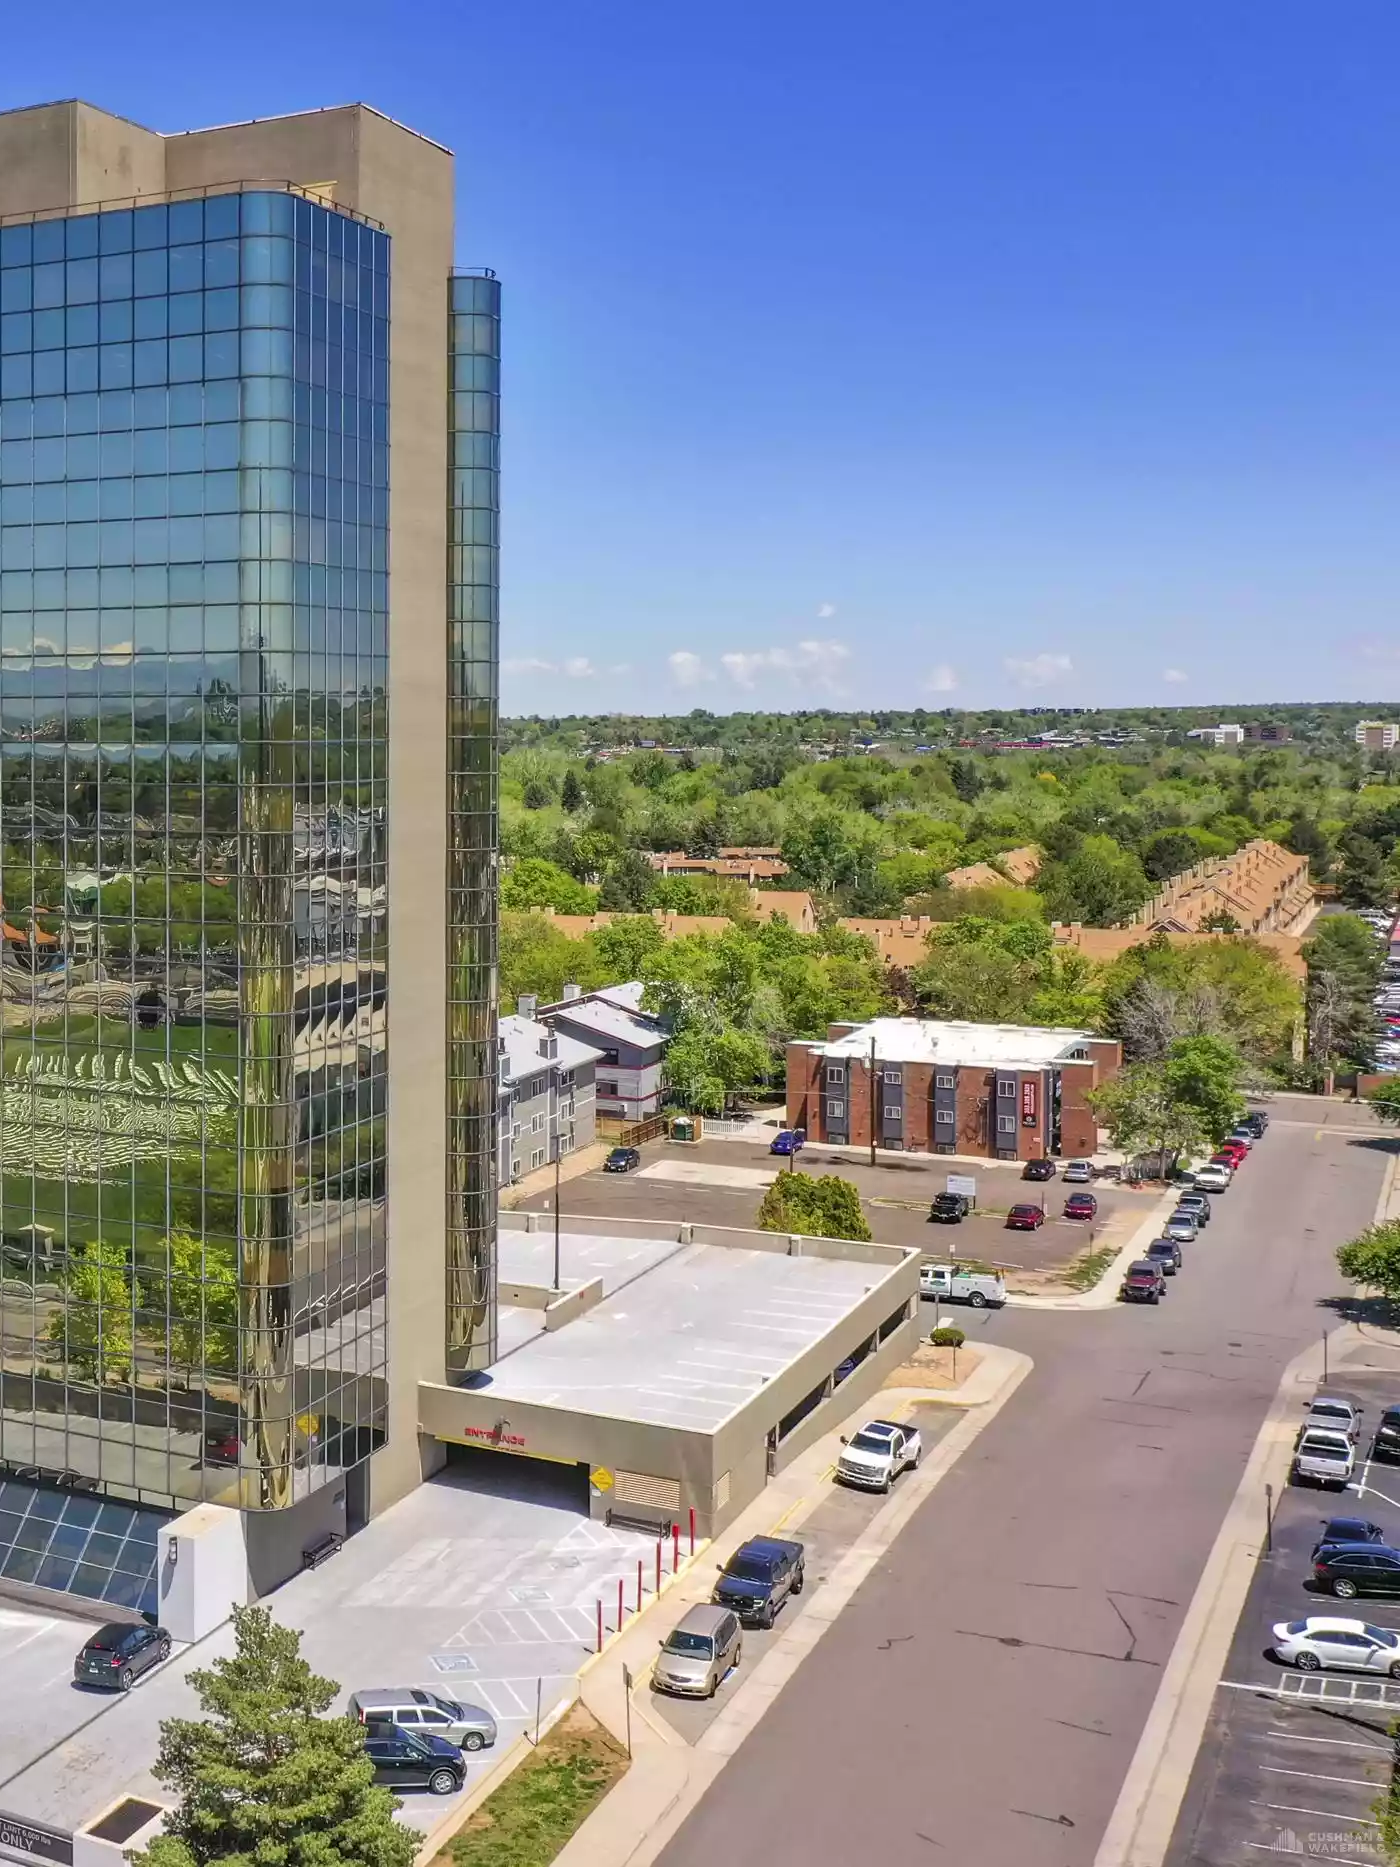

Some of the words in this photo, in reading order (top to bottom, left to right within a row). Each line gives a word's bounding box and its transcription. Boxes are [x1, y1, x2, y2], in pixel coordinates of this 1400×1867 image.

[464, 1427, 526, 1447] ENTRNCE
[3, 1823, 21, 1835] LIMIT
[0, 1830, 34, 1852] ONLY
